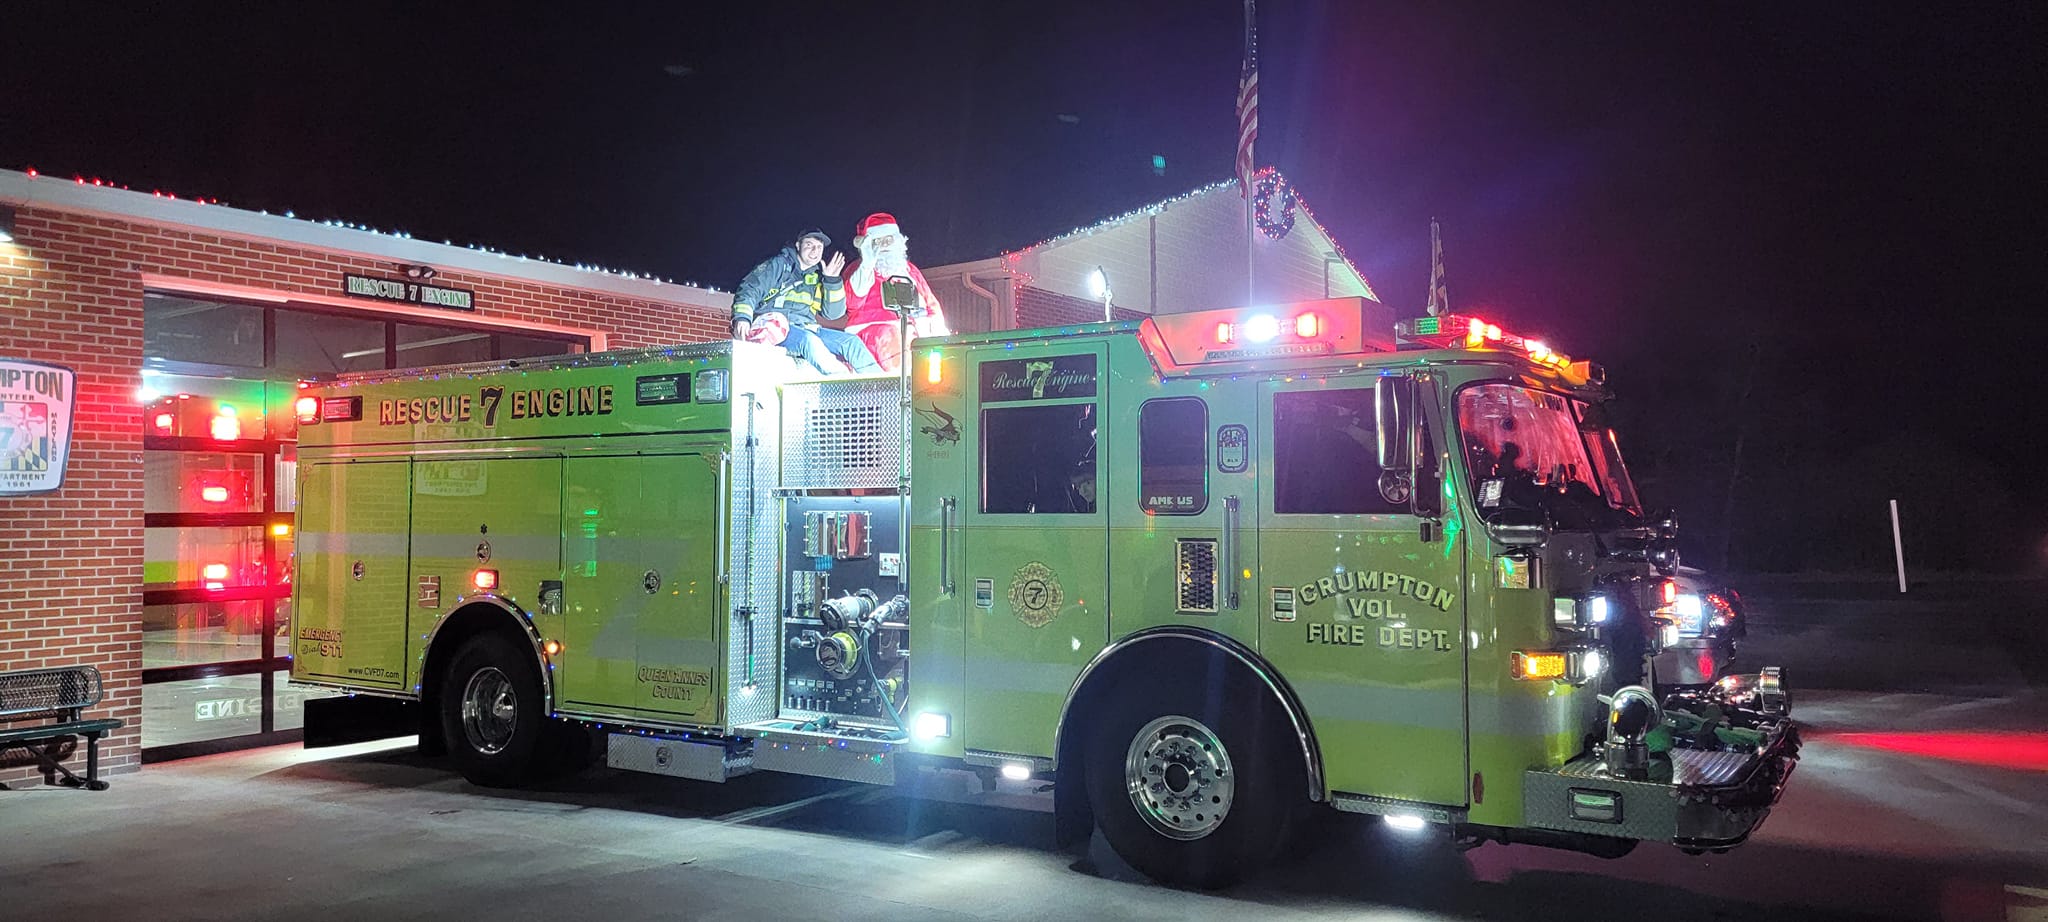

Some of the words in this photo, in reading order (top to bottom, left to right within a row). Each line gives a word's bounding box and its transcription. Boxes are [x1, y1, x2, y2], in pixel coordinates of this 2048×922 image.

[348, 276, 405, 299] RESCUE
[409, 285, 418, 301] 7
[422, 286, 471, 309] ENGINE
[1026, 361, 1054, 398] 7
[379, 394, 471, 426] RESCUE
[479, 385, 505, 429] 7
[511, 385, 613, 419] ENGINE
[1029, 587, 1043, 604] 7
[1299, 570, 1456, 612] CRUMPTON
[1349, 597, 1407, 619] VOL.
[299, 627, 344, 642] EMERGENCY
[1307, 622, 1365, 646] FIRE
[1378, 626, 1452, 651] DEPT.
[320, 643, 344, 658] 911
[638, 665, 673, 683] QUEEN
[652, 684, 695, 701] COUNTY
